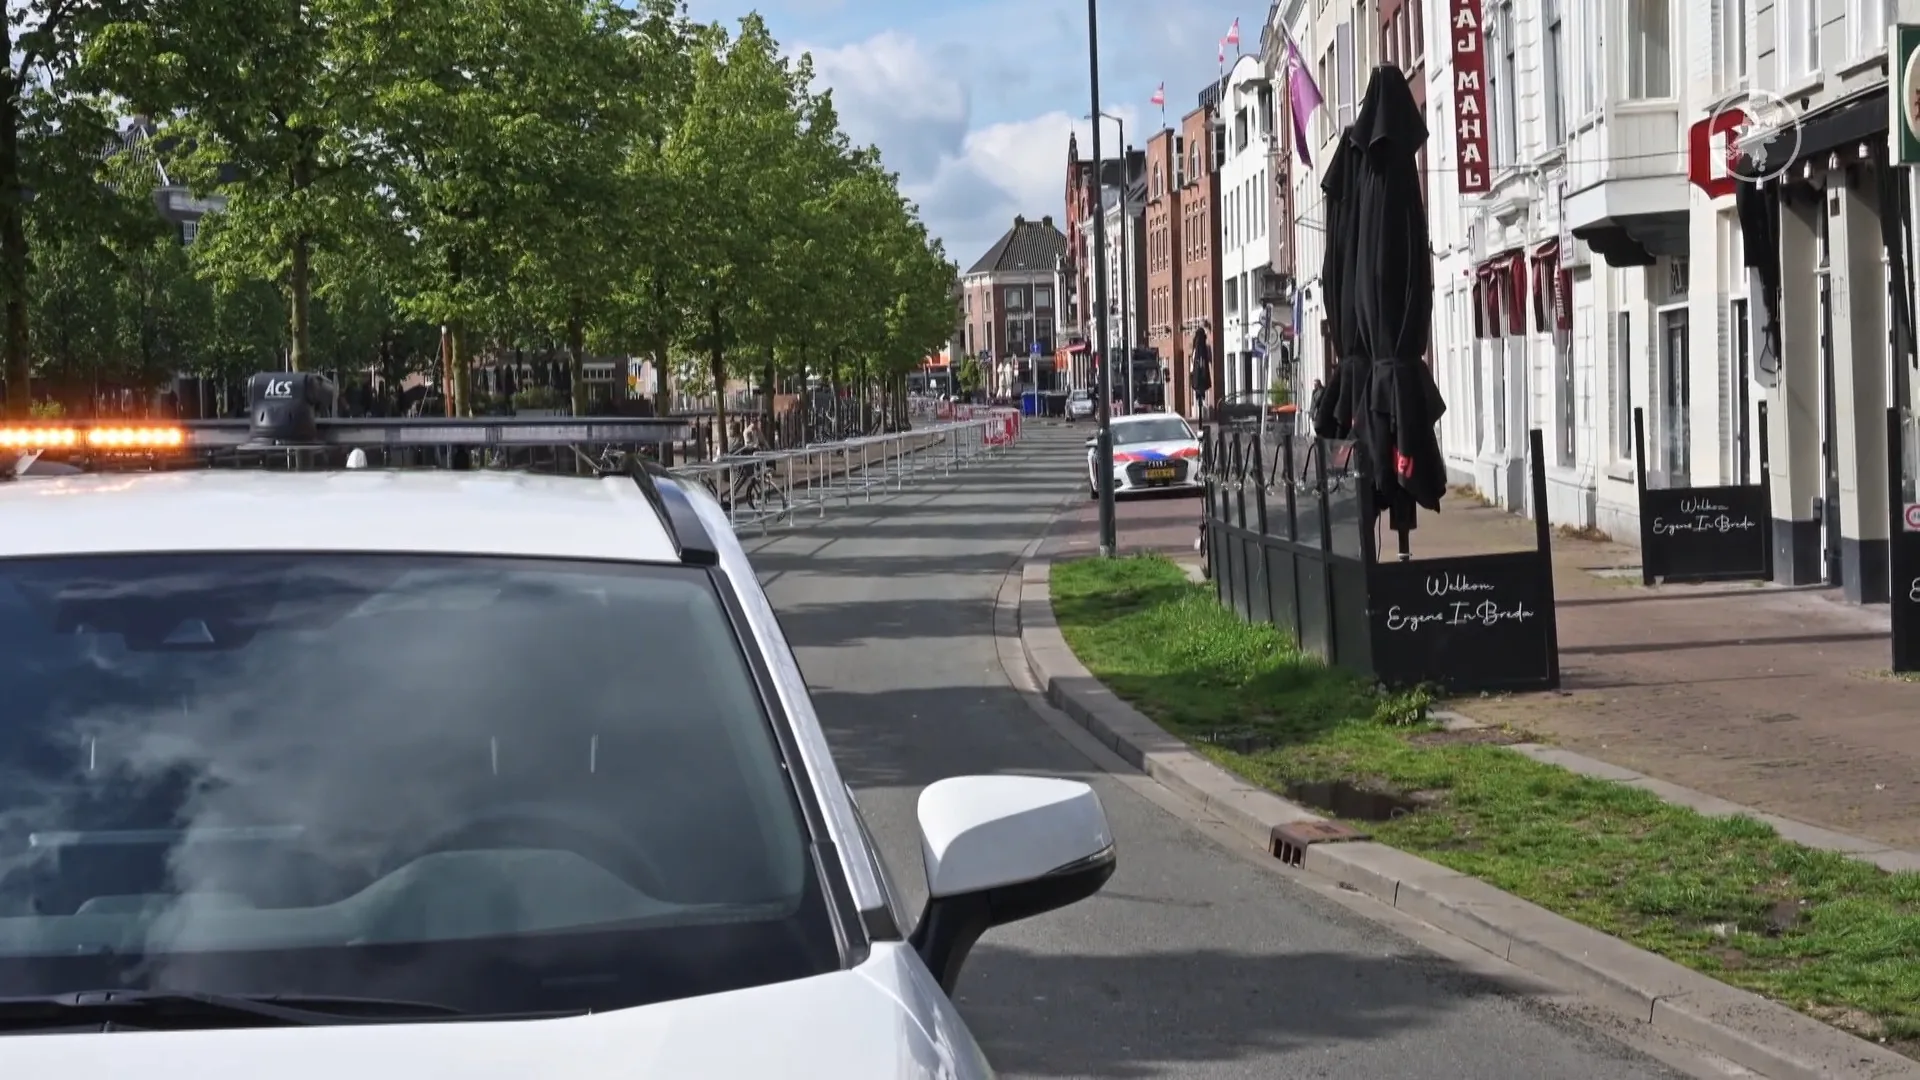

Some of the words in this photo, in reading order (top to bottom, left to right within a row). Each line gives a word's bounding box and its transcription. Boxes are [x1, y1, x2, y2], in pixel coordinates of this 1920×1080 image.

[1453, 0, 1478, 52] AJ
[1457, 71, 1482, 188] MAHAL
[1680, 496, 1729, 513] Welkom
[1652, 517, 1693, 535] Ergens
[1693, 515, 1714, 532] In
[1714, 514, 1756, 533] Breda
[1426, 572, 1495, 596] Welkom
[1387, 605, 1443, 632] Ergens
[1446, 601, 1476, 626] In
[1476, 599, 1534, 626] Breda
